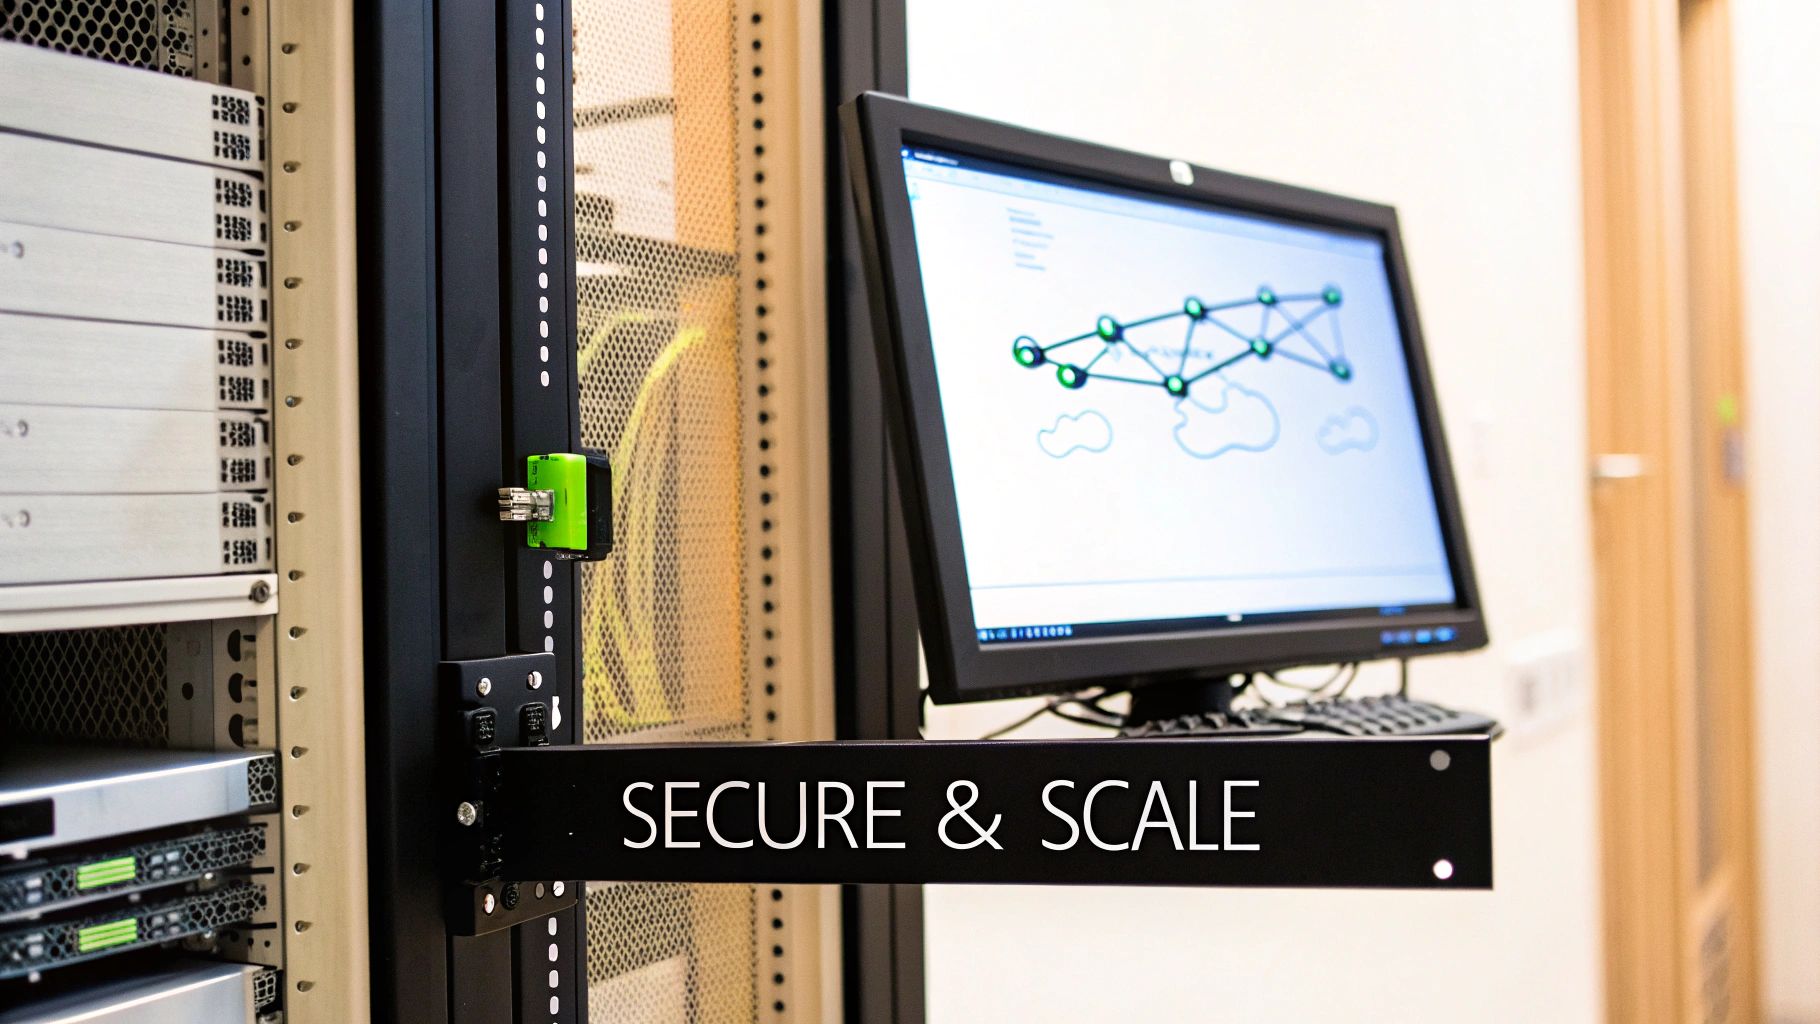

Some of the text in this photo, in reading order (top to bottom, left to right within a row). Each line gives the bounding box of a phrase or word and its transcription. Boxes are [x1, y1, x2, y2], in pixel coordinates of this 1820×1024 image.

[622, 779, 1261, 851] SECURE & SCALE
